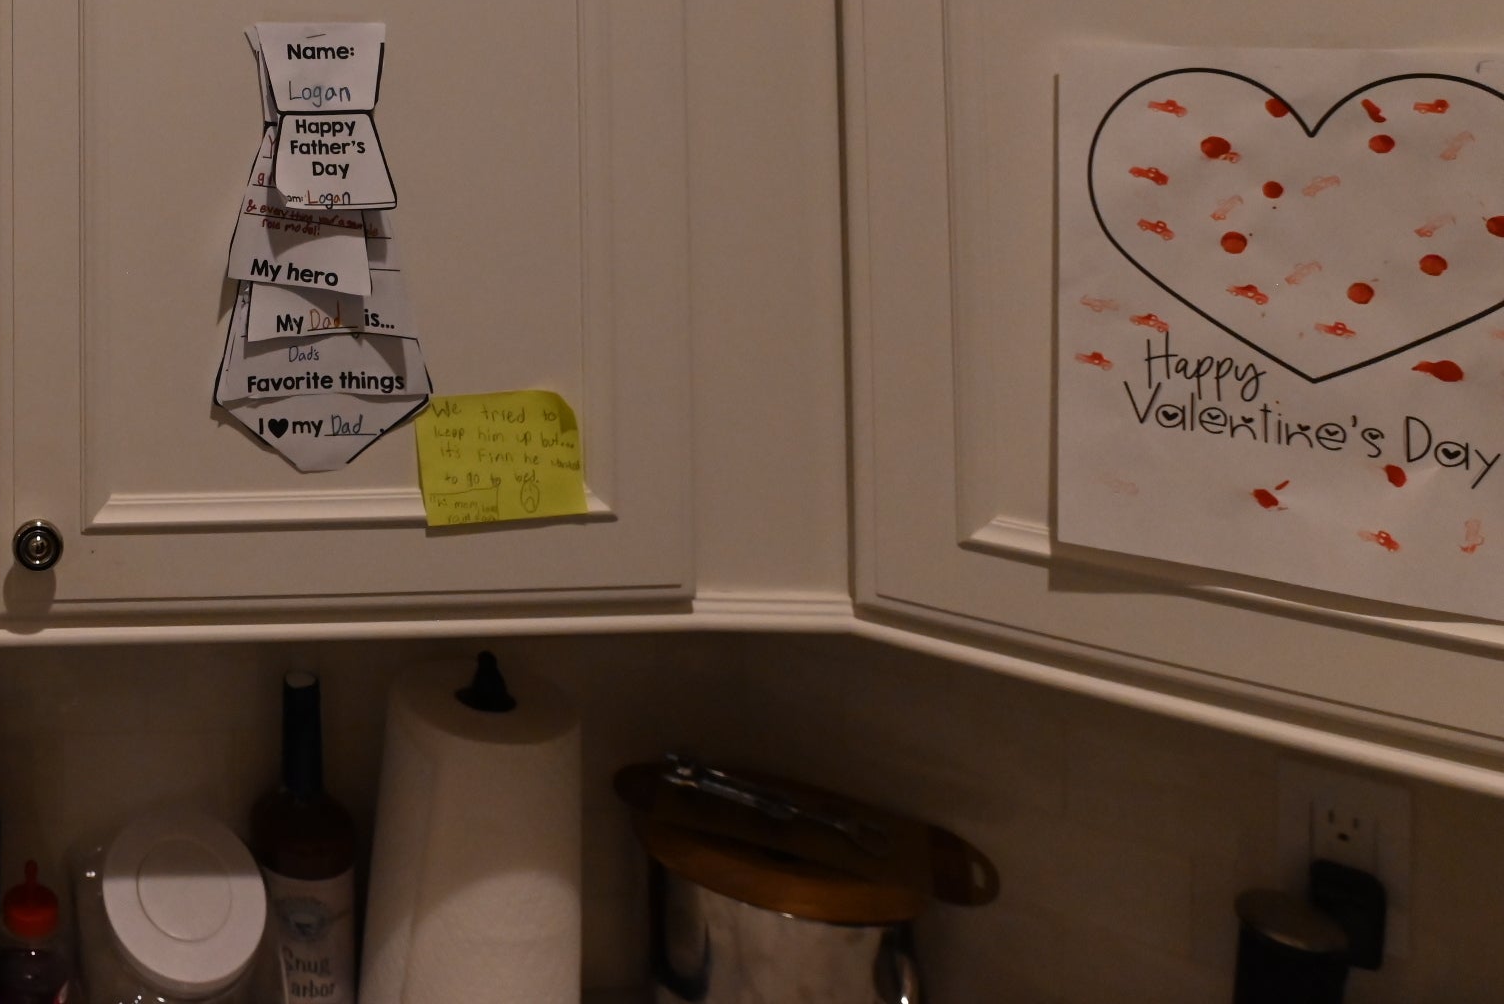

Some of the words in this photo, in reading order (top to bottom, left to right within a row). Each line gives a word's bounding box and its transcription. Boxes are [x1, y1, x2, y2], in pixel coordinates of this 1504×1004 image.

[286, 43, 355, 60] Name:
[288, 80, 351, 107] Logan
[294, 119, 356, 137] Happy
[289, 139, 366, 155] Father's
[311, 161, 350, 178] Day
[307, 190, 351, 209] Logan
[250, 258, 282, 282] My
[287, 262, 339, 286] hero
[276, 314, 304, 337] My
[309, 300, 342, 329] Dad
[364, 308, 395, 330] is...
[288, 345, 320, 363] Dad's
[1144, 331, 1267, 402] Happy
[247, 371, 333, 393] Favorite
[339, 370, 405, 394] things
[431, 400, 462, 417] We
[481, 406, 526, 423] tried
[542, 409, 557, 422] to
[258, 417, 264, 435] I
[291, 418, 324, 438] my
[478, 426, 504, 442] him
[516, 433, 533, 446] up
[1123, 381, 1385, 460] Valentine's
[1404, 415, 1501, 489] Day
[524, 452, 540, 464] he
[444, 473, 458, 484] to
[466, 472, 481, 487] go
[290, 979, 336, 999] arbor
